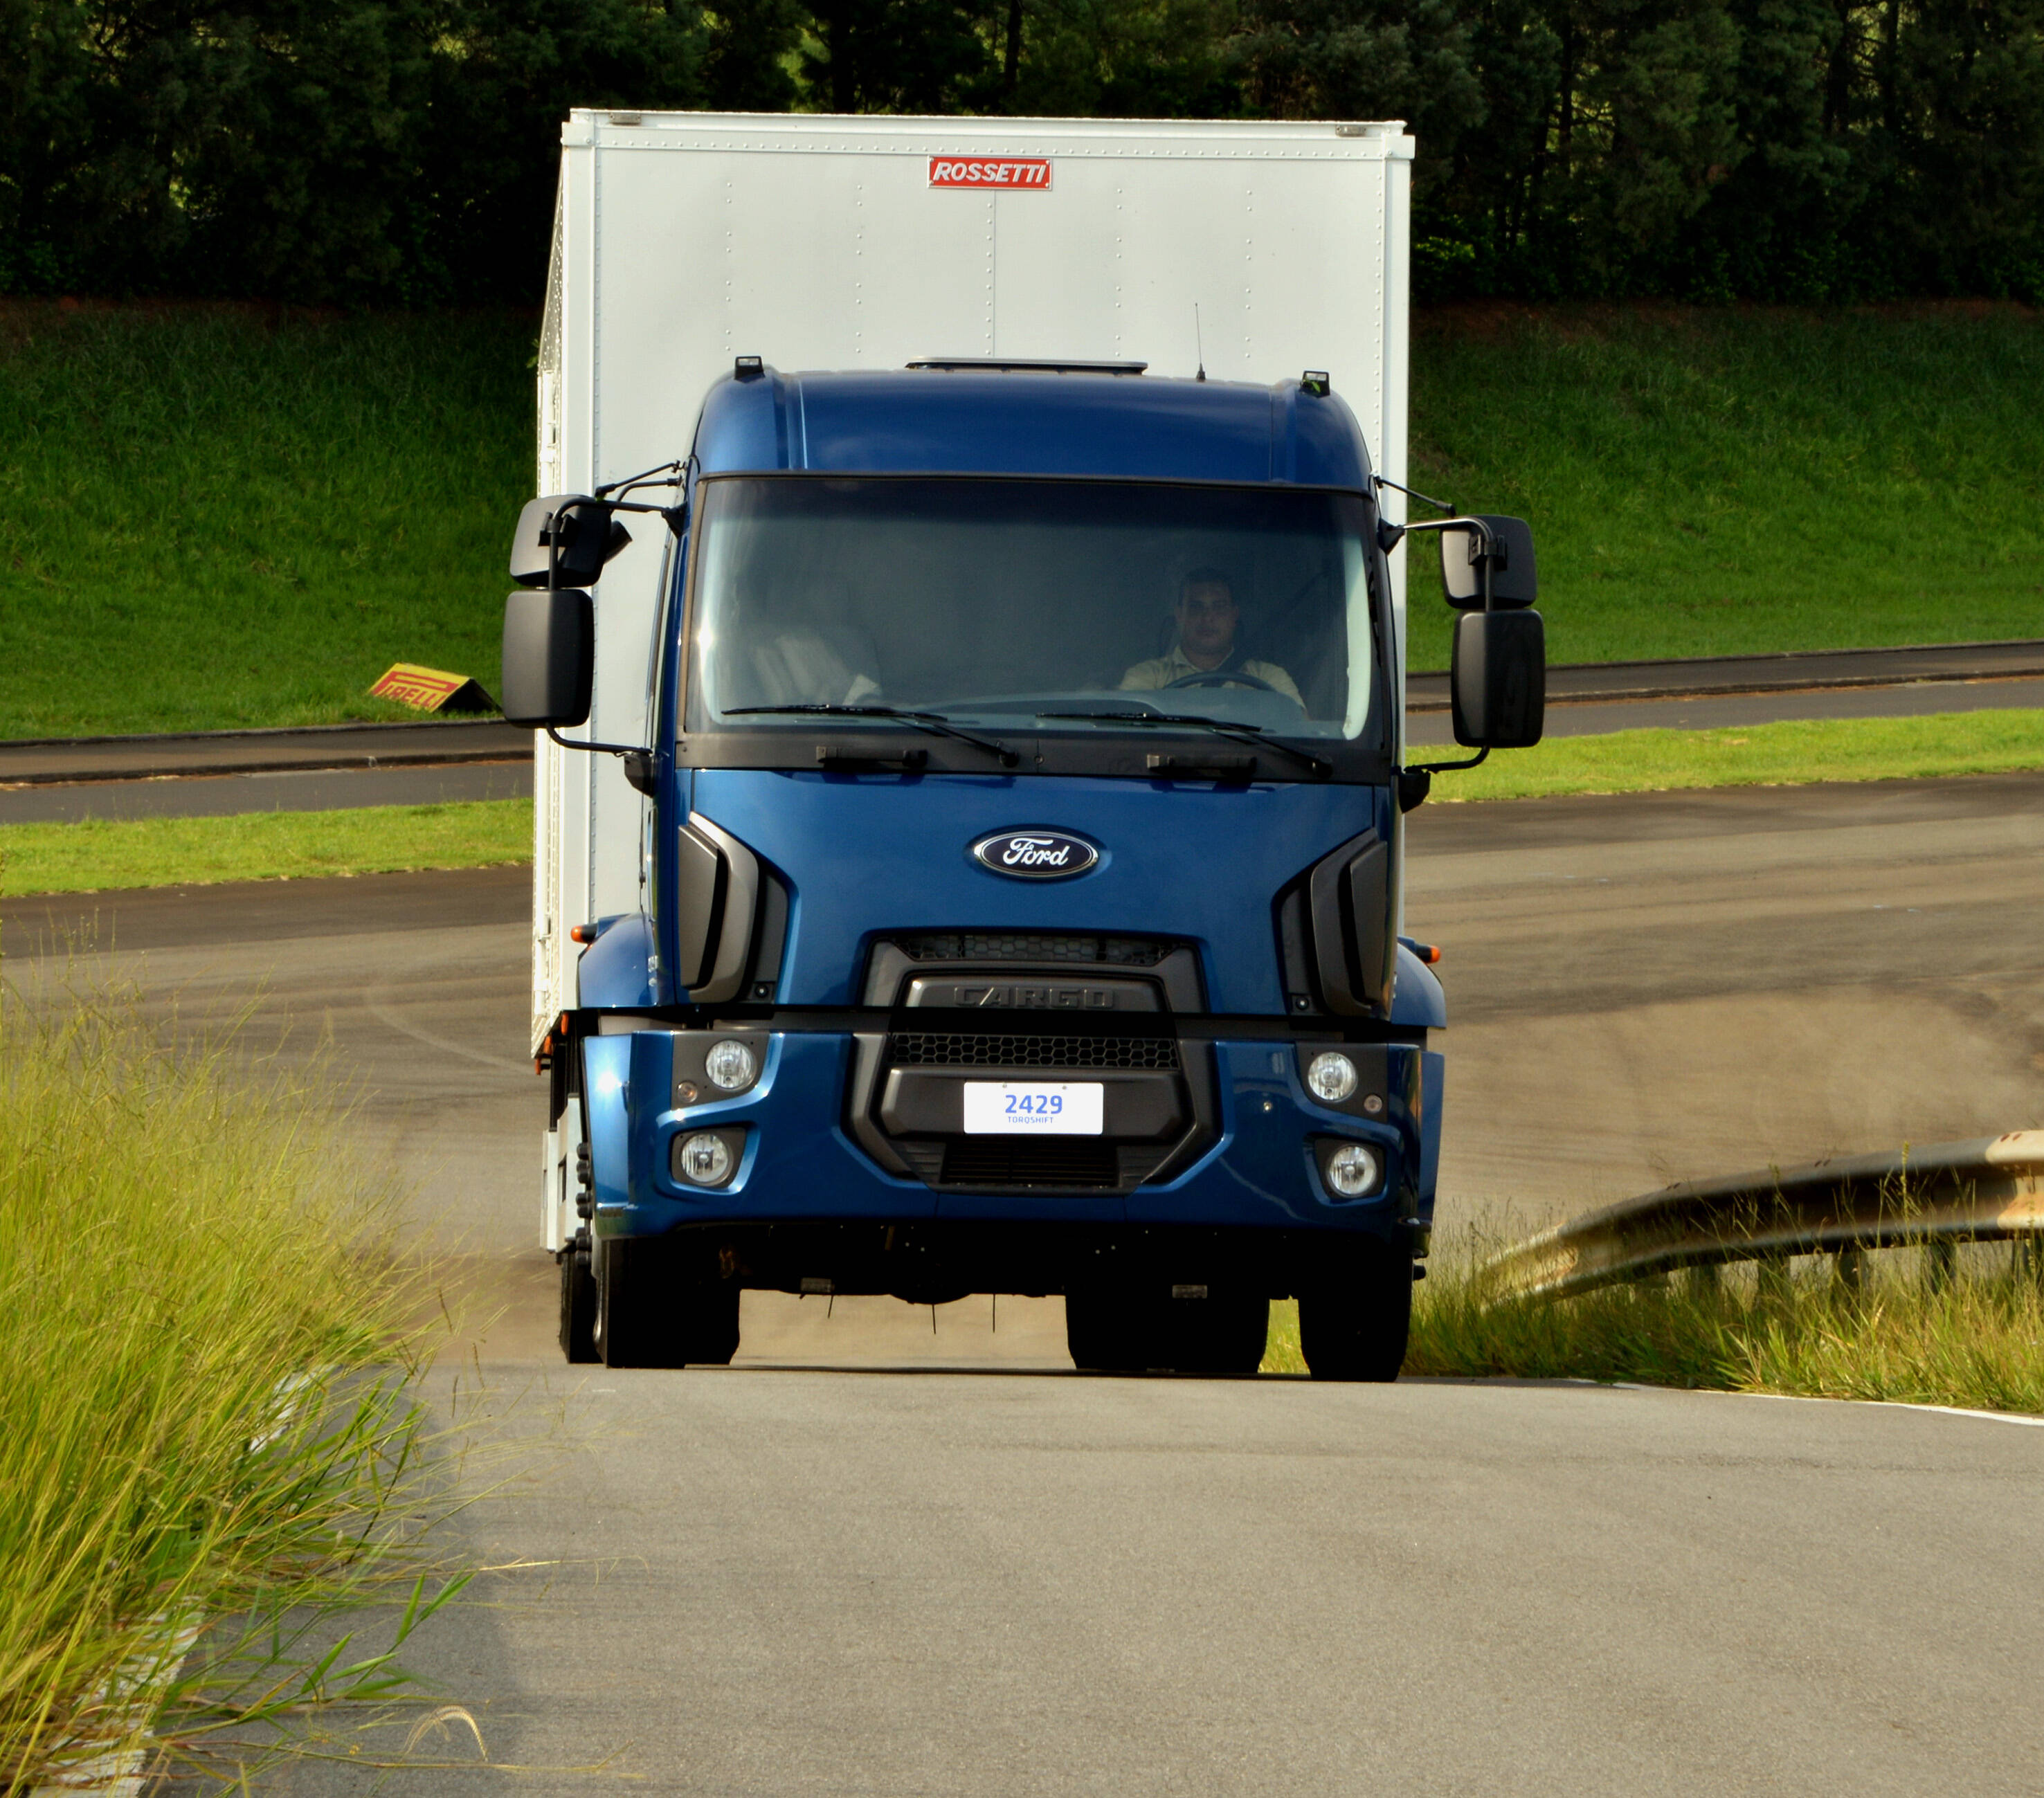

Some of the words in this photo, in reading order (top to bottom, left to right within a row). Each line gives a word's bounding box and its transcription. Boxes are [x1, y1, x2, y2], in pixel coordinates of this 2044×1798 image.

[932, 162, 1047, 183] ROSSETTI
[372, 671, 458, 708] PIRELLI
[1003, 837, 1070, 865] Ford
[953, 986, 1114, 1008] CARGO
[1005, 1094, 1062, 1114] 2429
